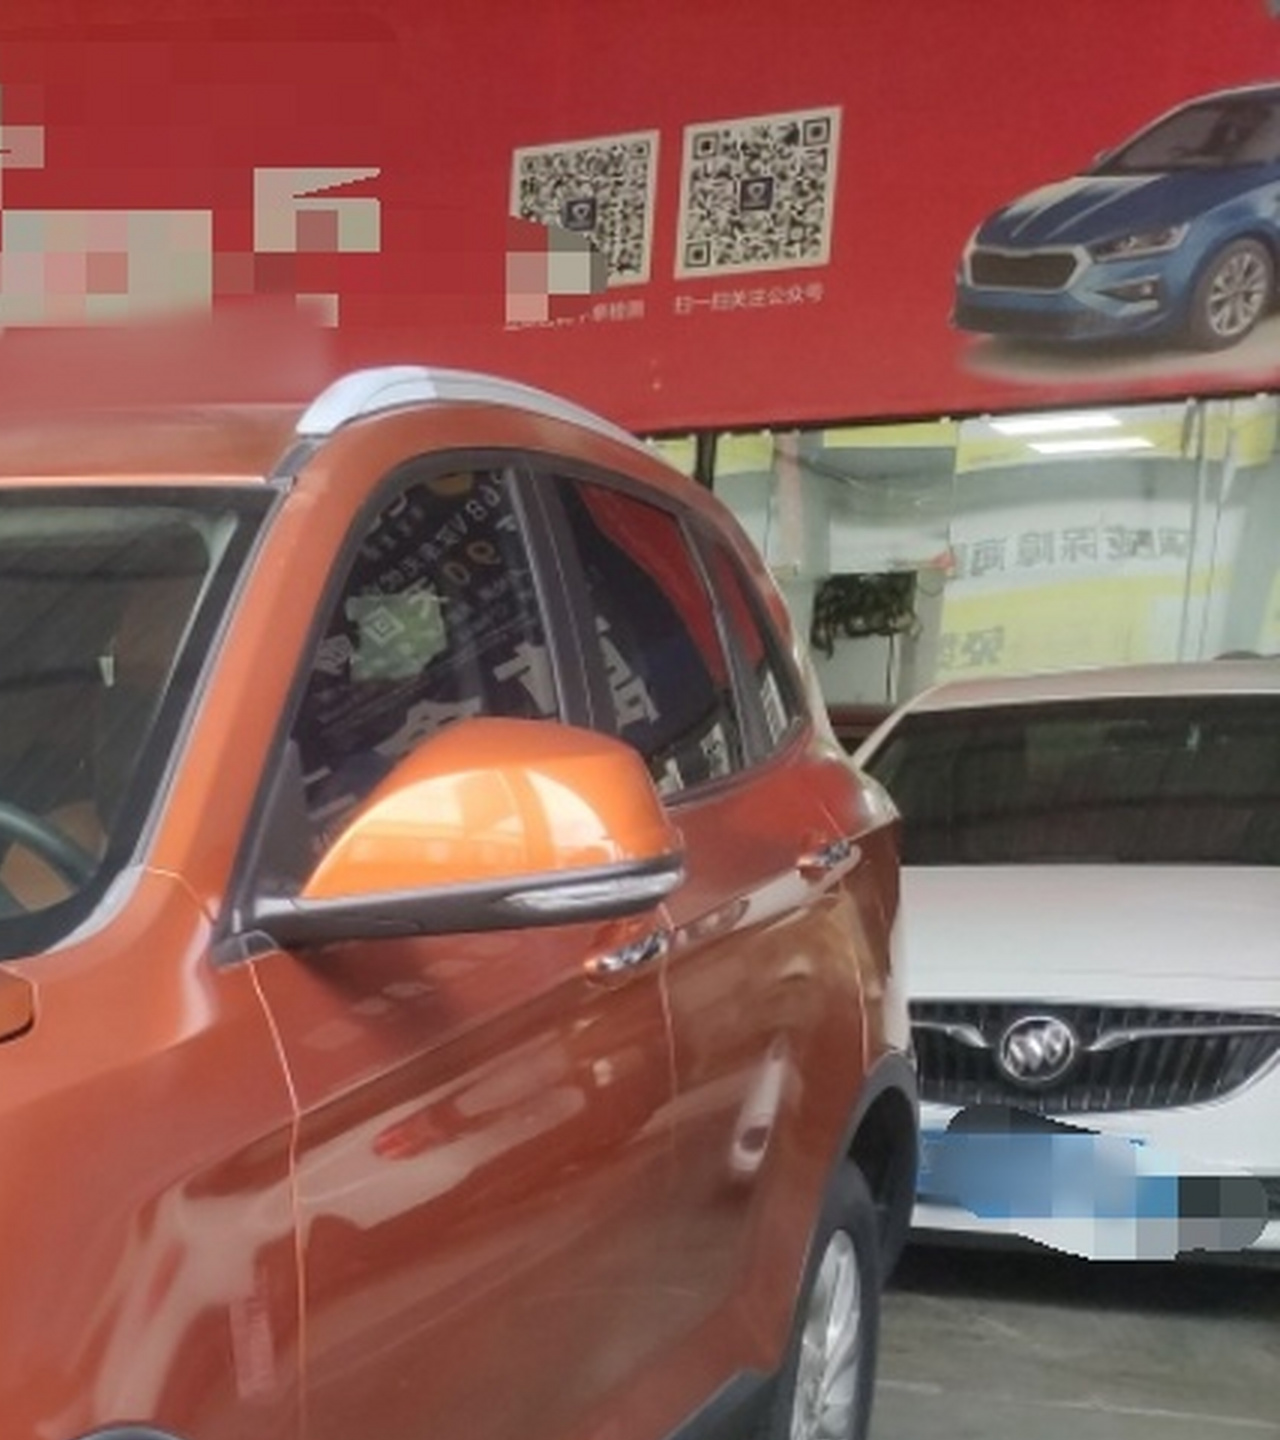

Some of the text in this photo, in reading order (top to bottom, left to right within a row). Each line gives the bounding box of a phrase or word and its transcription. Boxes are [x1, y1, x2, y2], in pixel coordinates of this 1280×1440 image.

[674, 282, 825, 315] 扫一扫关注公众号
